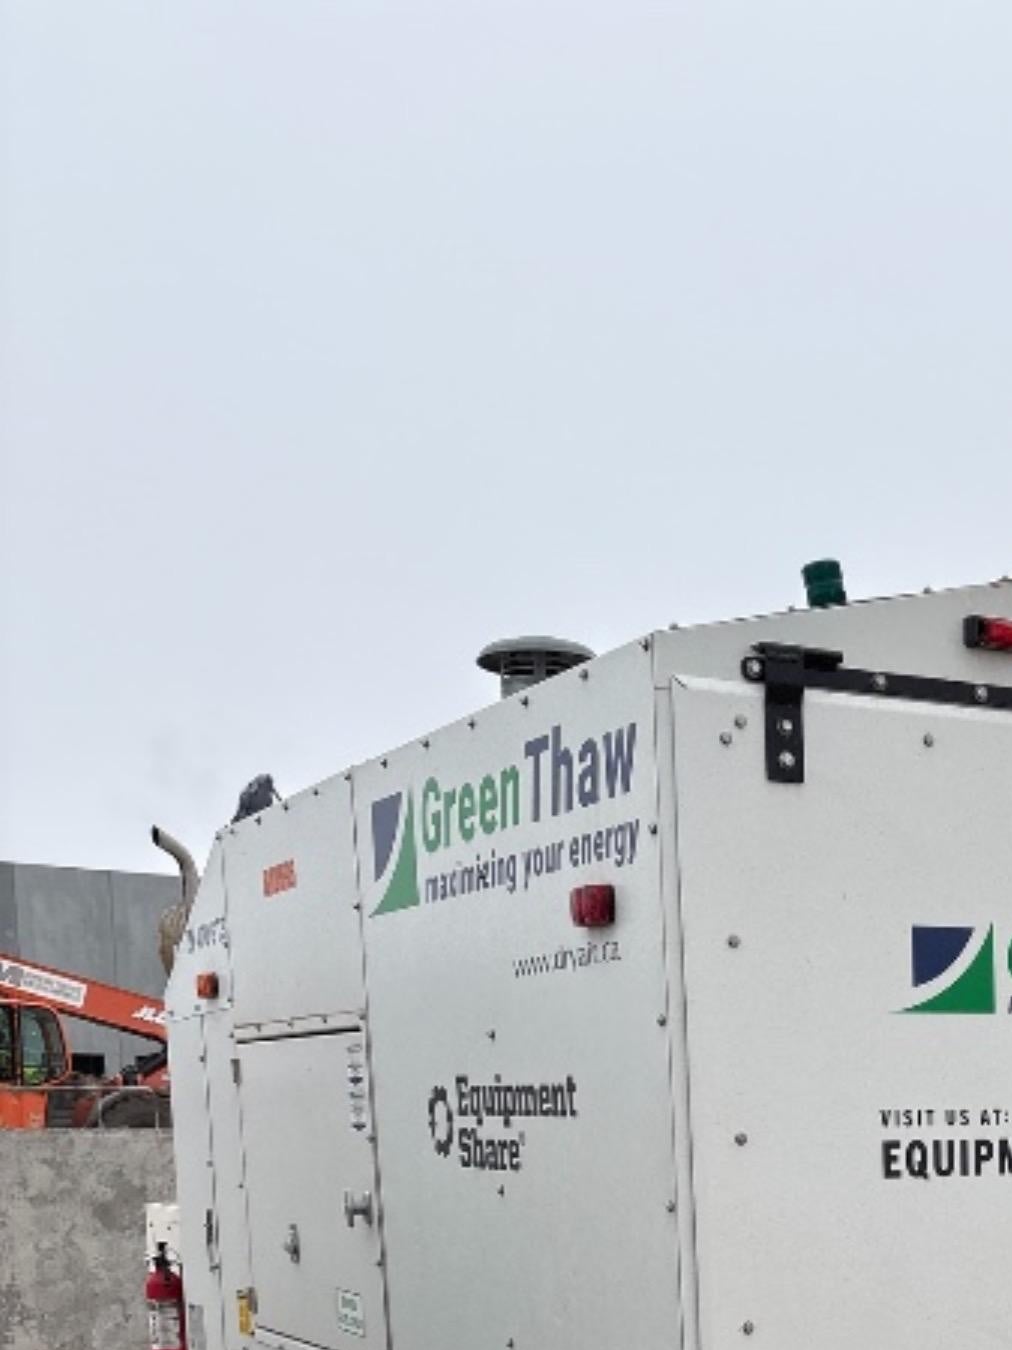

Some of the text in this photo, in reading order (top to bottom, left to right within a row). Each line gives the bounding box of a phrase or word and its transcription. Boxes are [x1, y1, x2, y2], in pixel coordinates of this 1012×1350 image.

[425, 819, 639, 903] maximizing your energy
[455, 1074, 577, 1128] Equipment
[880, 1109, 1009, 1126] VISIT US AT:
